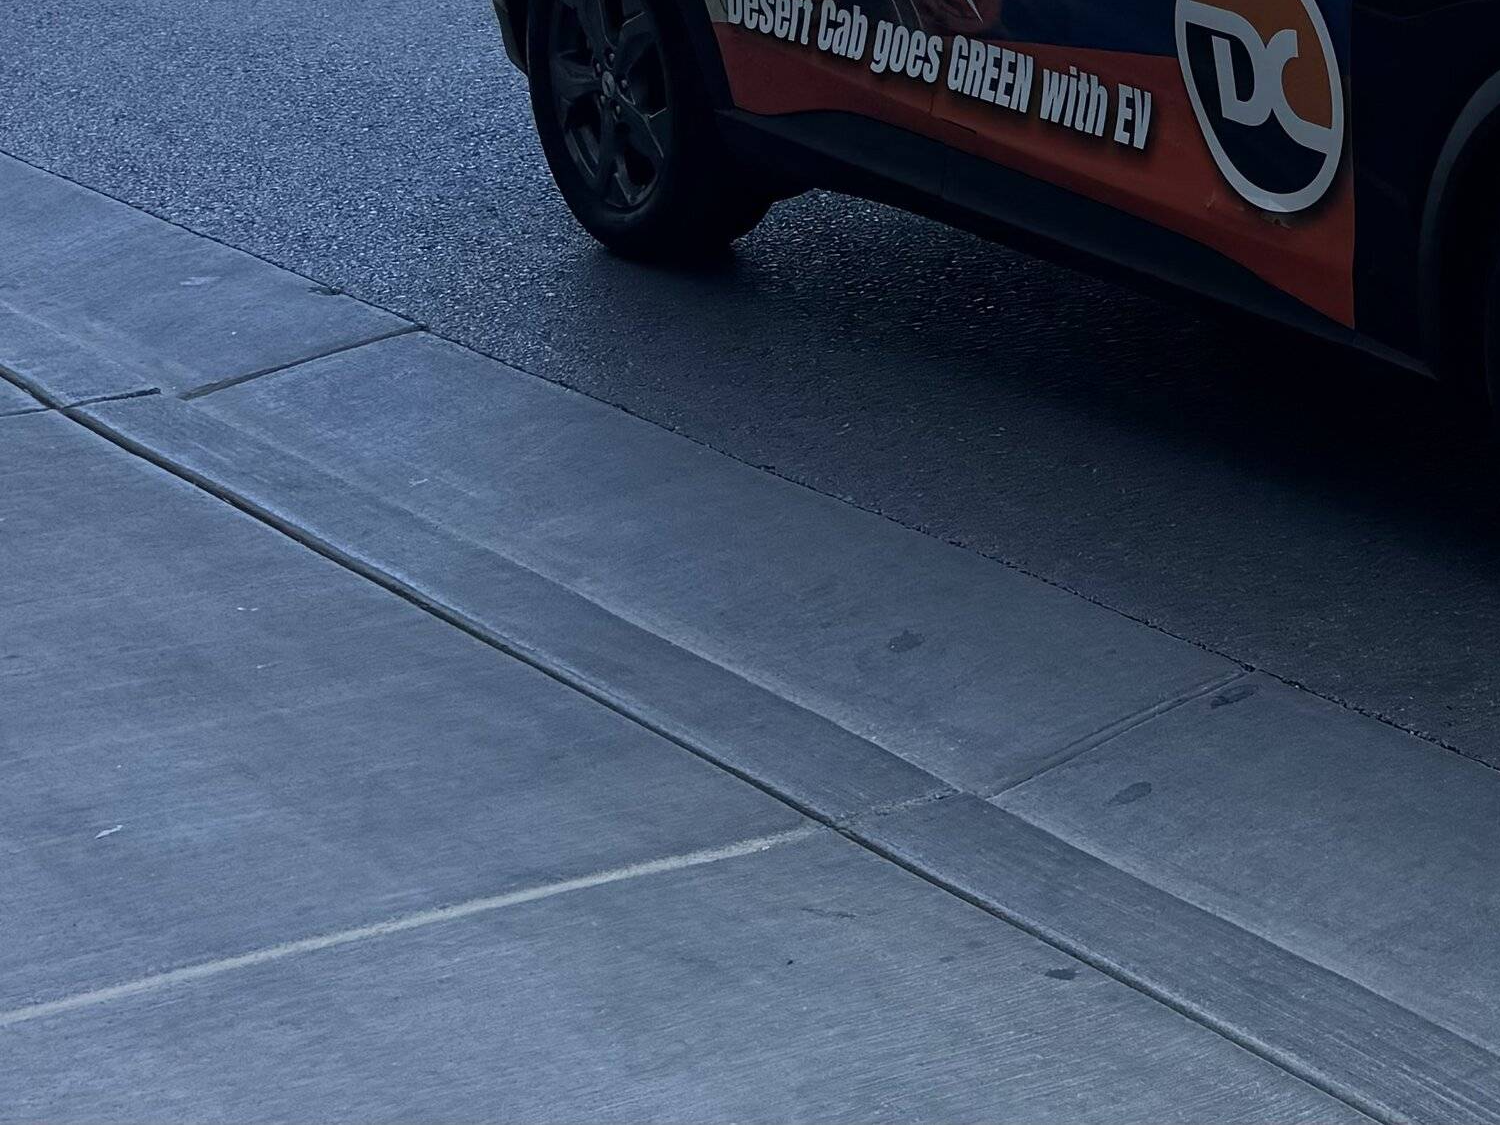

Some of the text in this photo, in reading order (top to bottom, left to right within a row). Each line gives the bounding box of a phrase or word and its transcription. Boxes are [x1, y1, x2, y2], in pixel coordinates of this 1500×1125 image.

[869, 17, 942, 84] goes
[947, 34, 1034, 113] GREEN
[1038, 64, 1108, 138] with
[1113, 82, 1152, 150] EV
